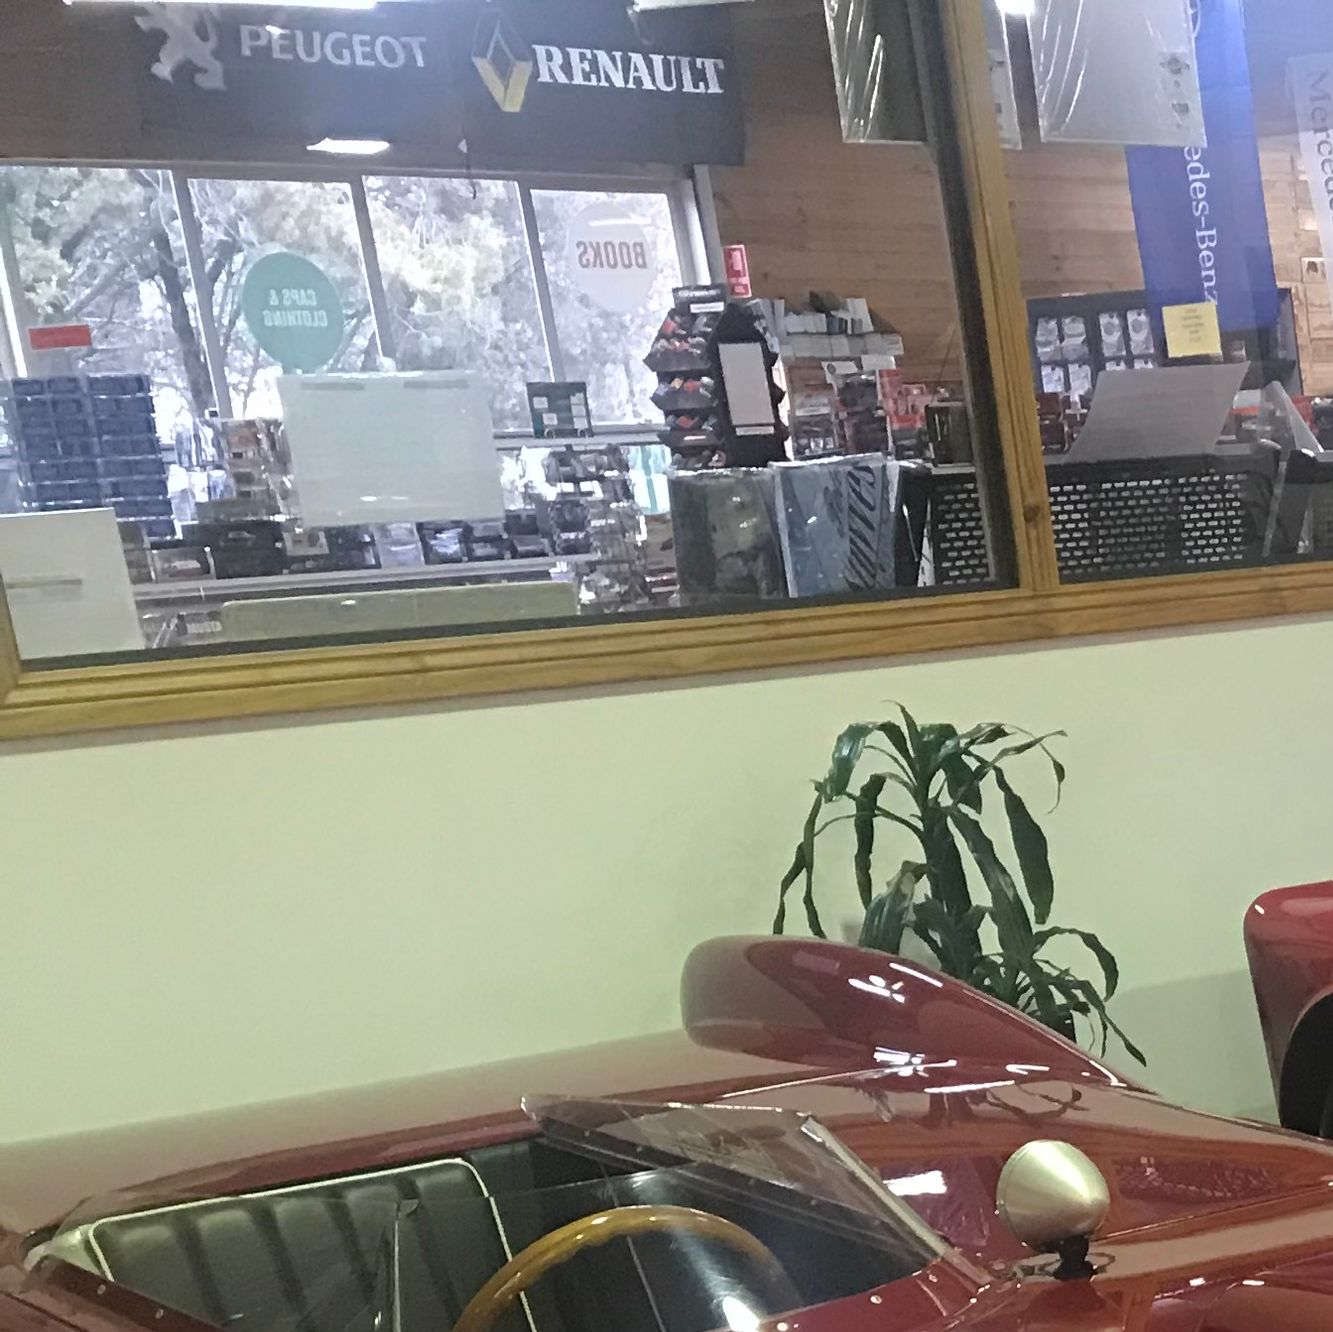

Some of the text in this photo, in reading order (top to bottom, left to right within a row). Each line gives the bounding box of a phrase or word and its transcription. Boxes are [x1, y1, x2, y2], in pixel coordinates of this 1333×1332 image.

[239, 24, 428, 68] PEUGEOT
[531, 44, 725, 94] RENAULT
[1183, 146, 1218, 305] edes-Benz
